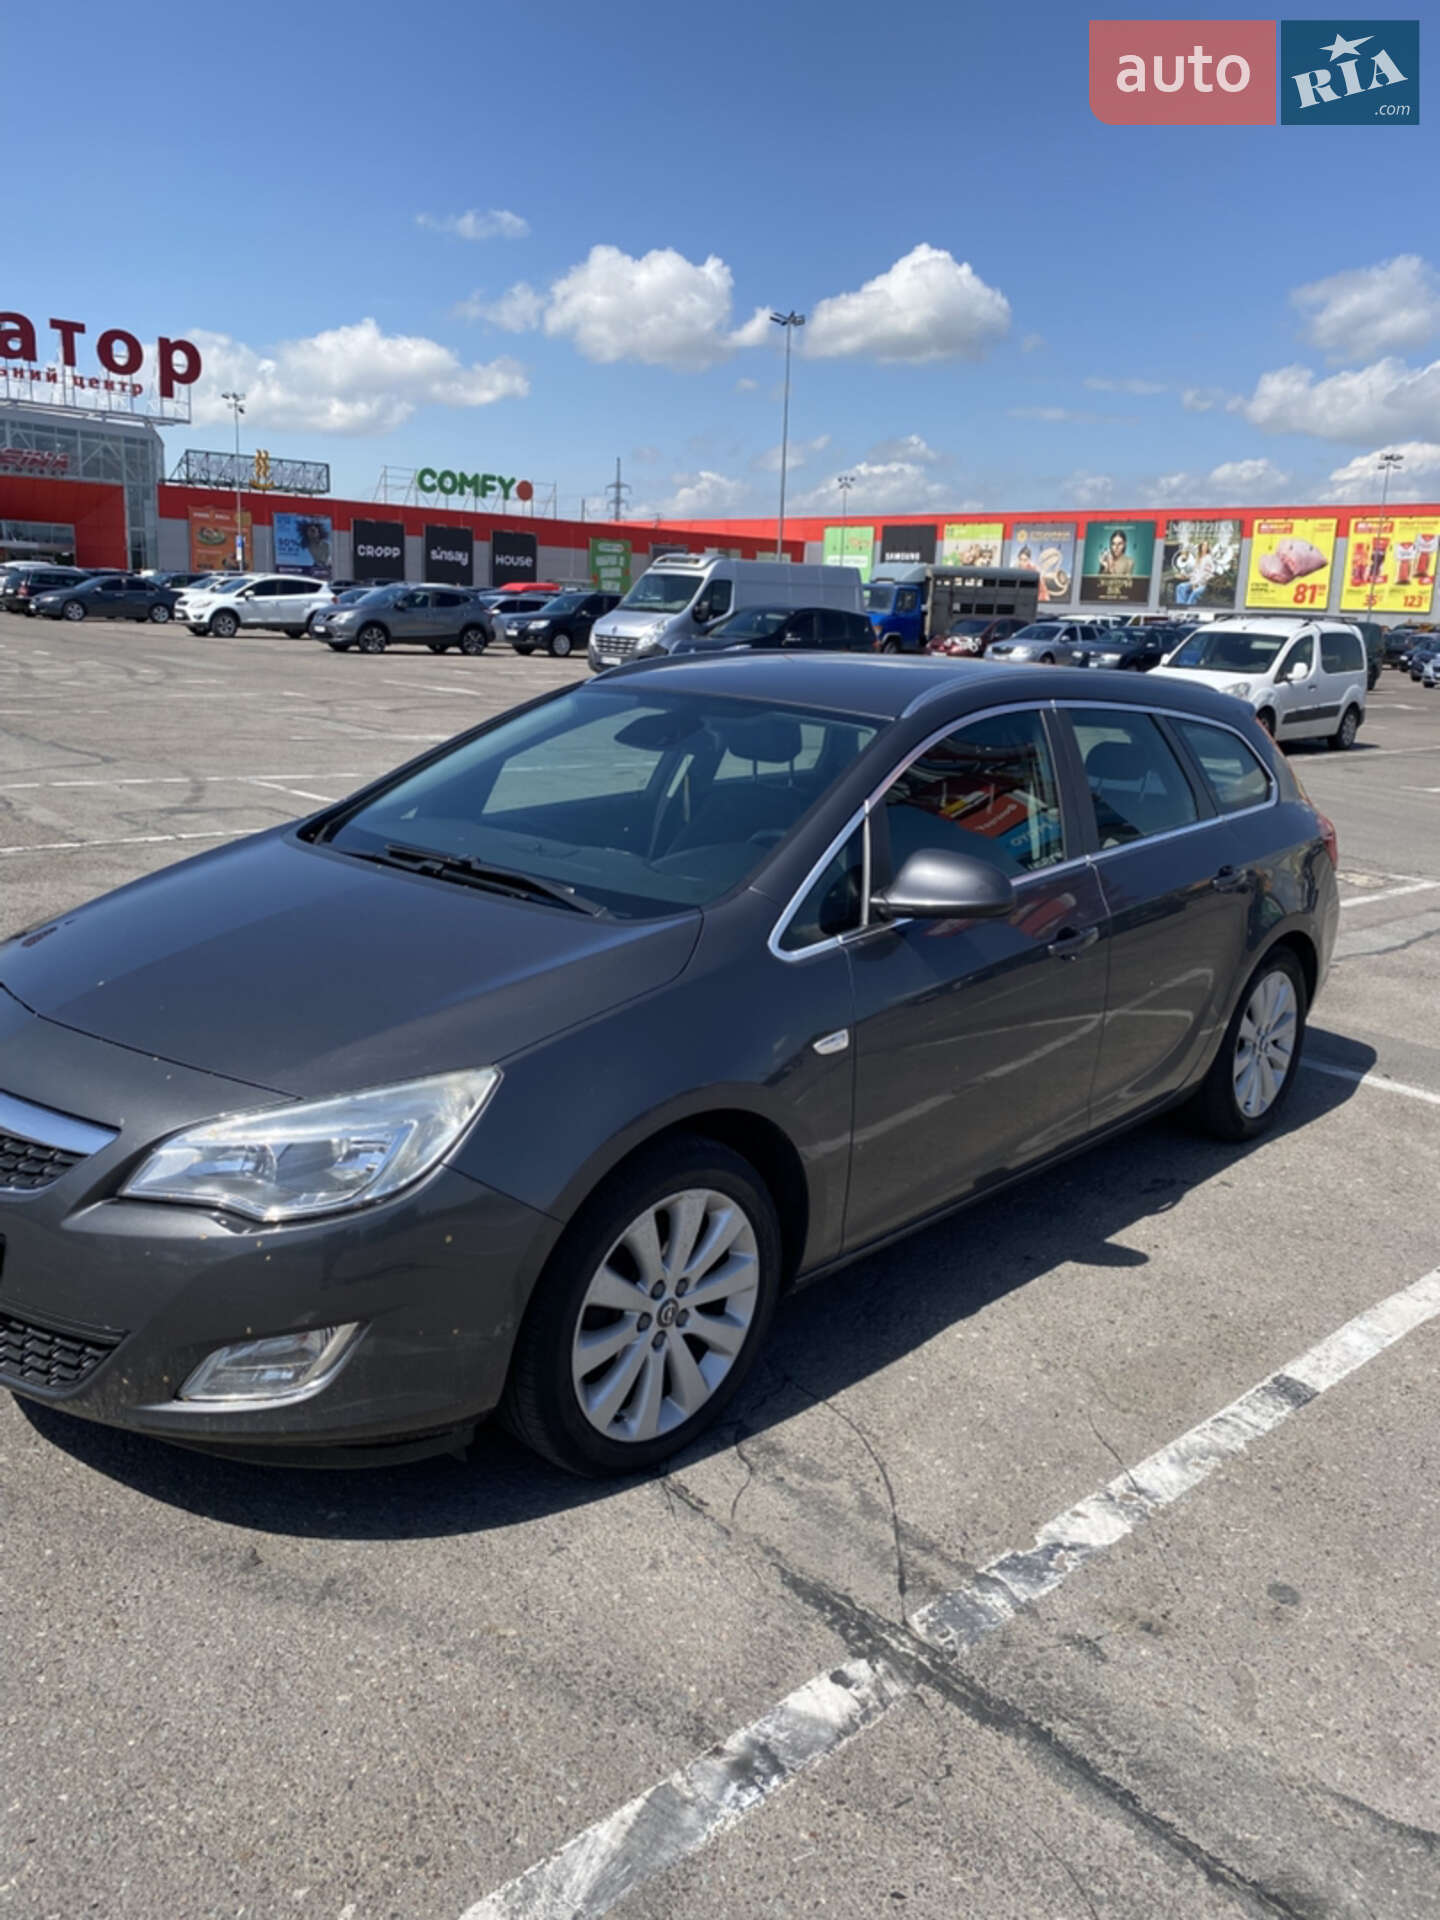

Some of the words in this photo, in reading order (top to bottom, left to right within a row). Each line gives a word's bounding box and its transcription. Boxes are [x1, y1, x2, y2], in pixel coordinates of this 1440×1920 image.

[72, 374, 144, 398] центр
[417, 467, 516, 501] COMFY
[357, 544, 401, 559] CROPP
[430, 546, 469, 566] sinsay
[884, 551, 921, 561] SAMSUNG
[1293, 583, 1318, 604] 81
[1403, 595, 1423, 608] 123
